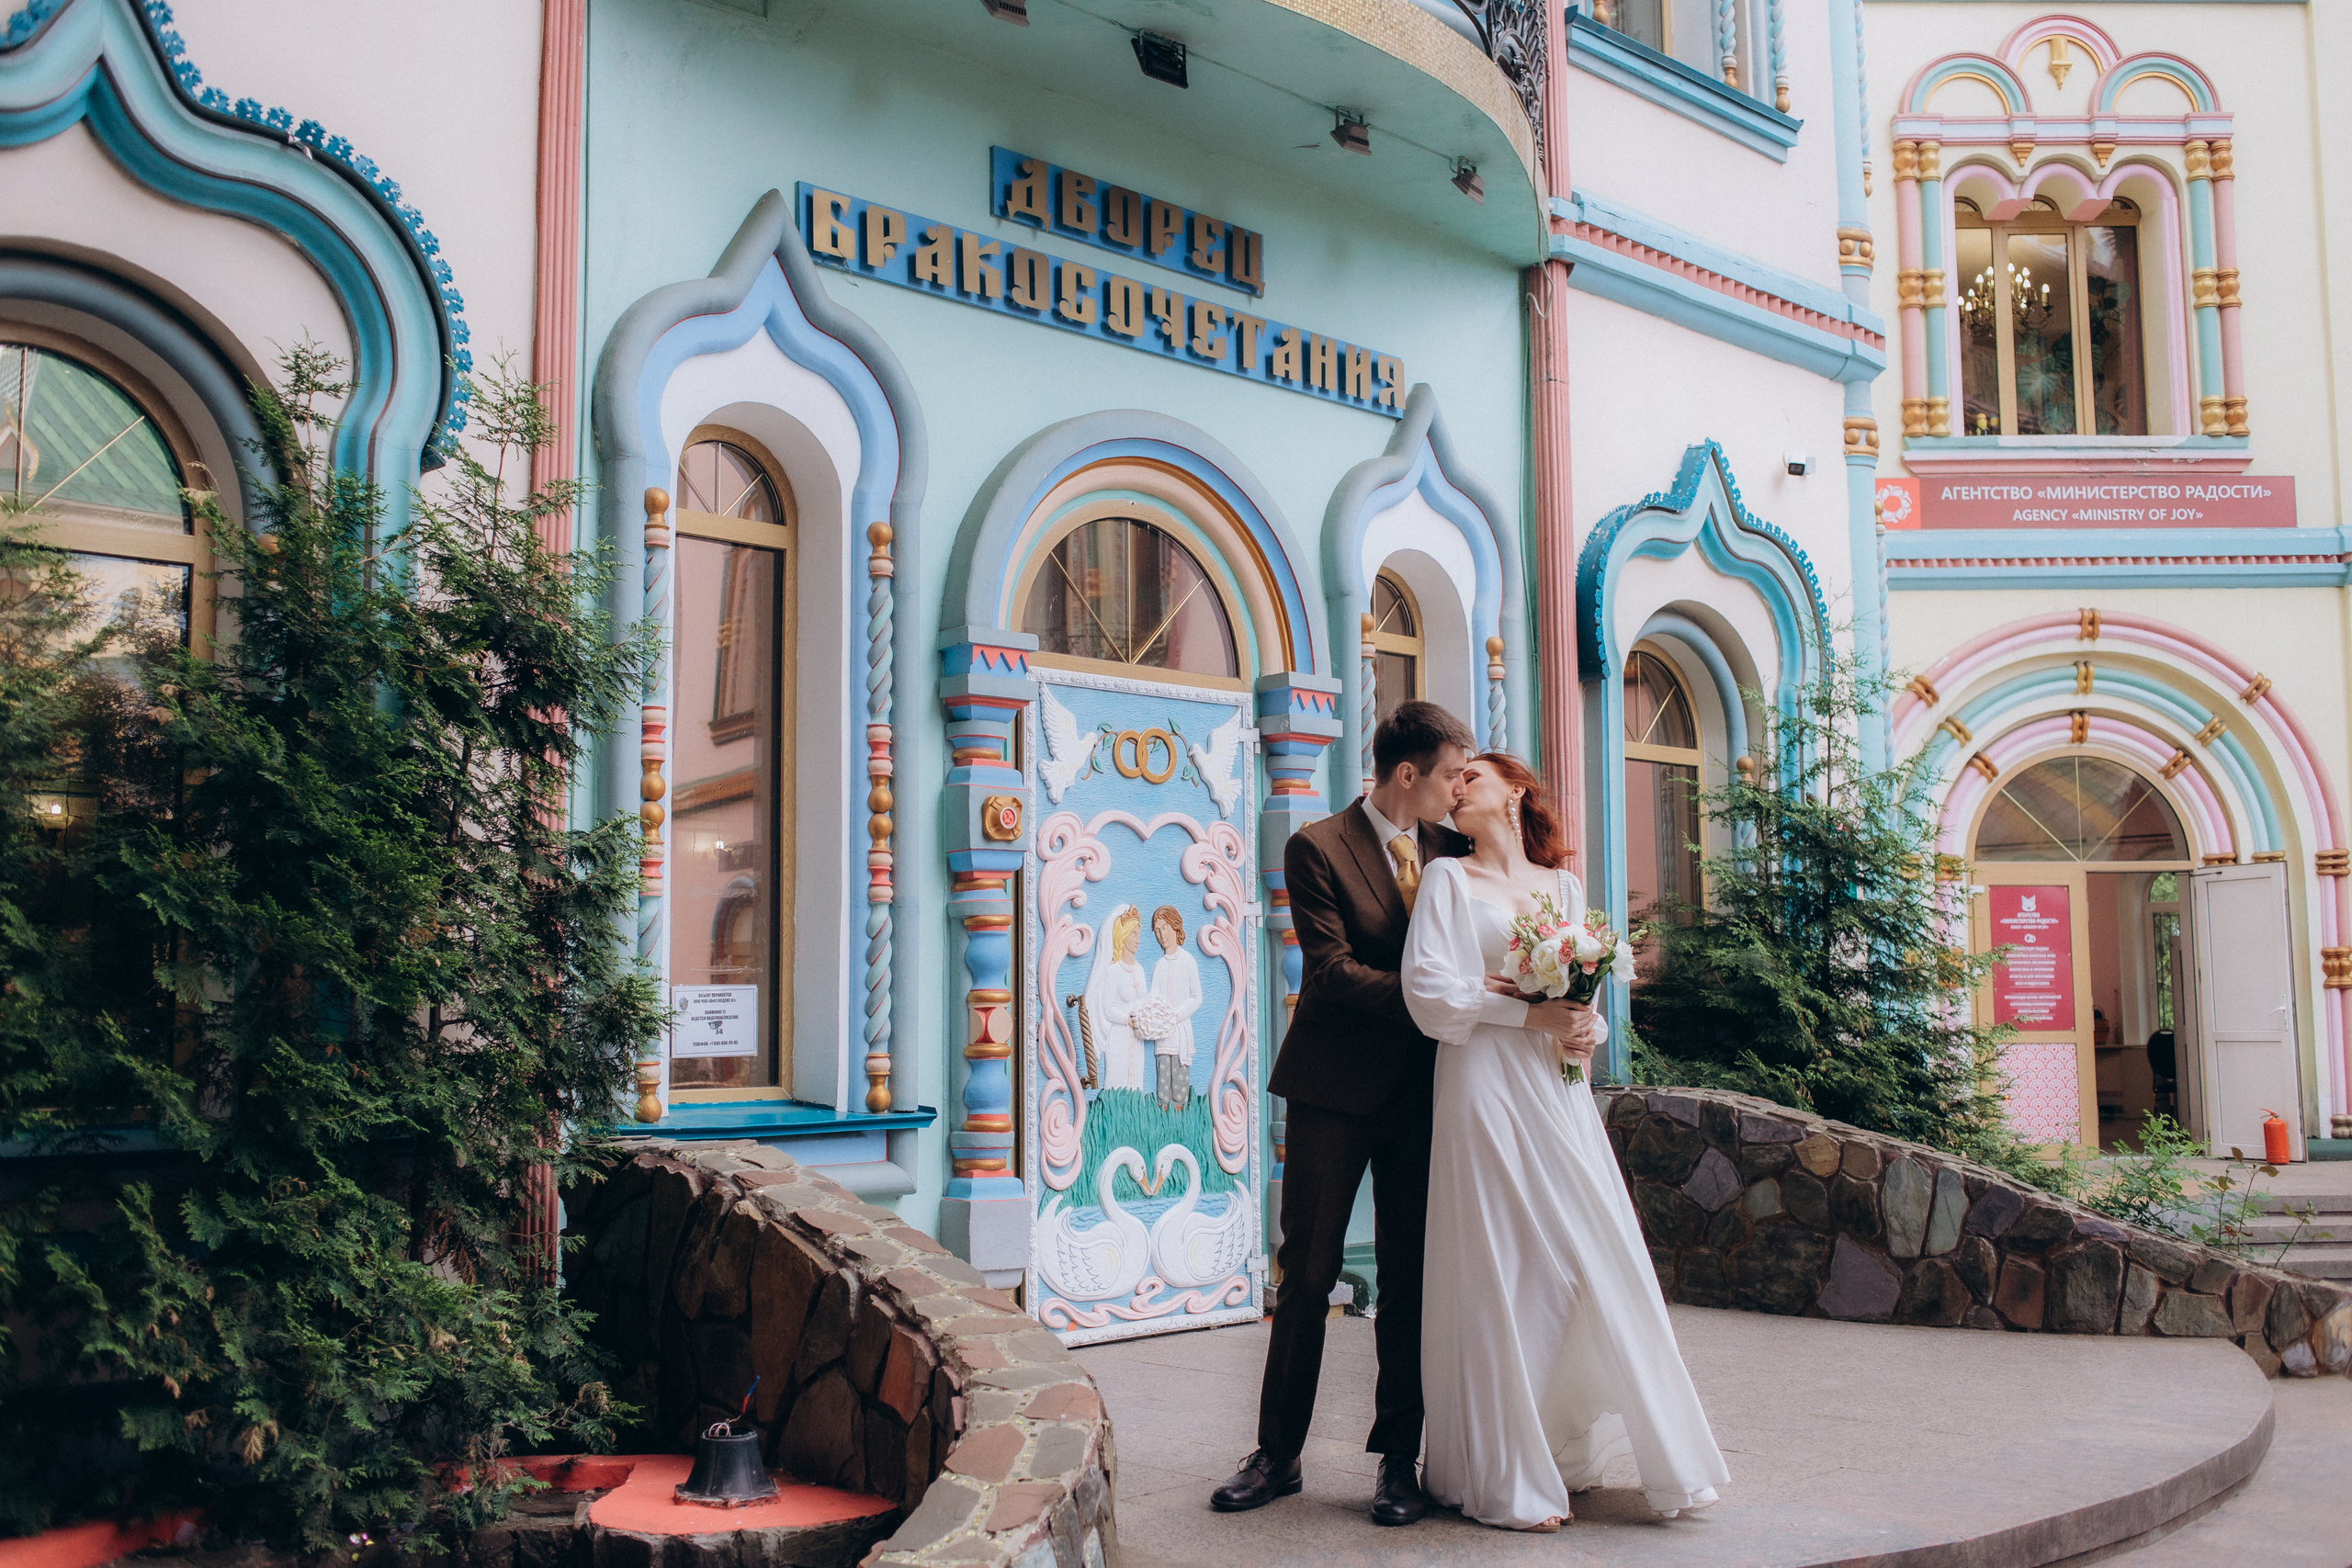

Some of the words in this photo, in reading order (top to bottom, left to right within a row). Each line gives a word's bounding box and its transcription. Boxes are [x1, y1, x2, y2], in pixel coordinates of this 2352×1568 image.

[1006, 157, 1266, 299] ДВОРЕЦ
[811, 187, 1407, 411] БРАКОСОЧЕТАНИЯ
[1940, 485, 2033, 501] АГЕНТСТВО
[2037, 485, 2181, 501] «МИНИСТЕРСТВО
[2185, 484, 2272, 502] РАДОСТИ»
[2012, 508, 2068, 522] AGENCY
[2071, 508, 2144, 522] «MINISTRY
[2148, 508, 2167, 521] OF
[2170, 508, 2204, 521] JOY»
